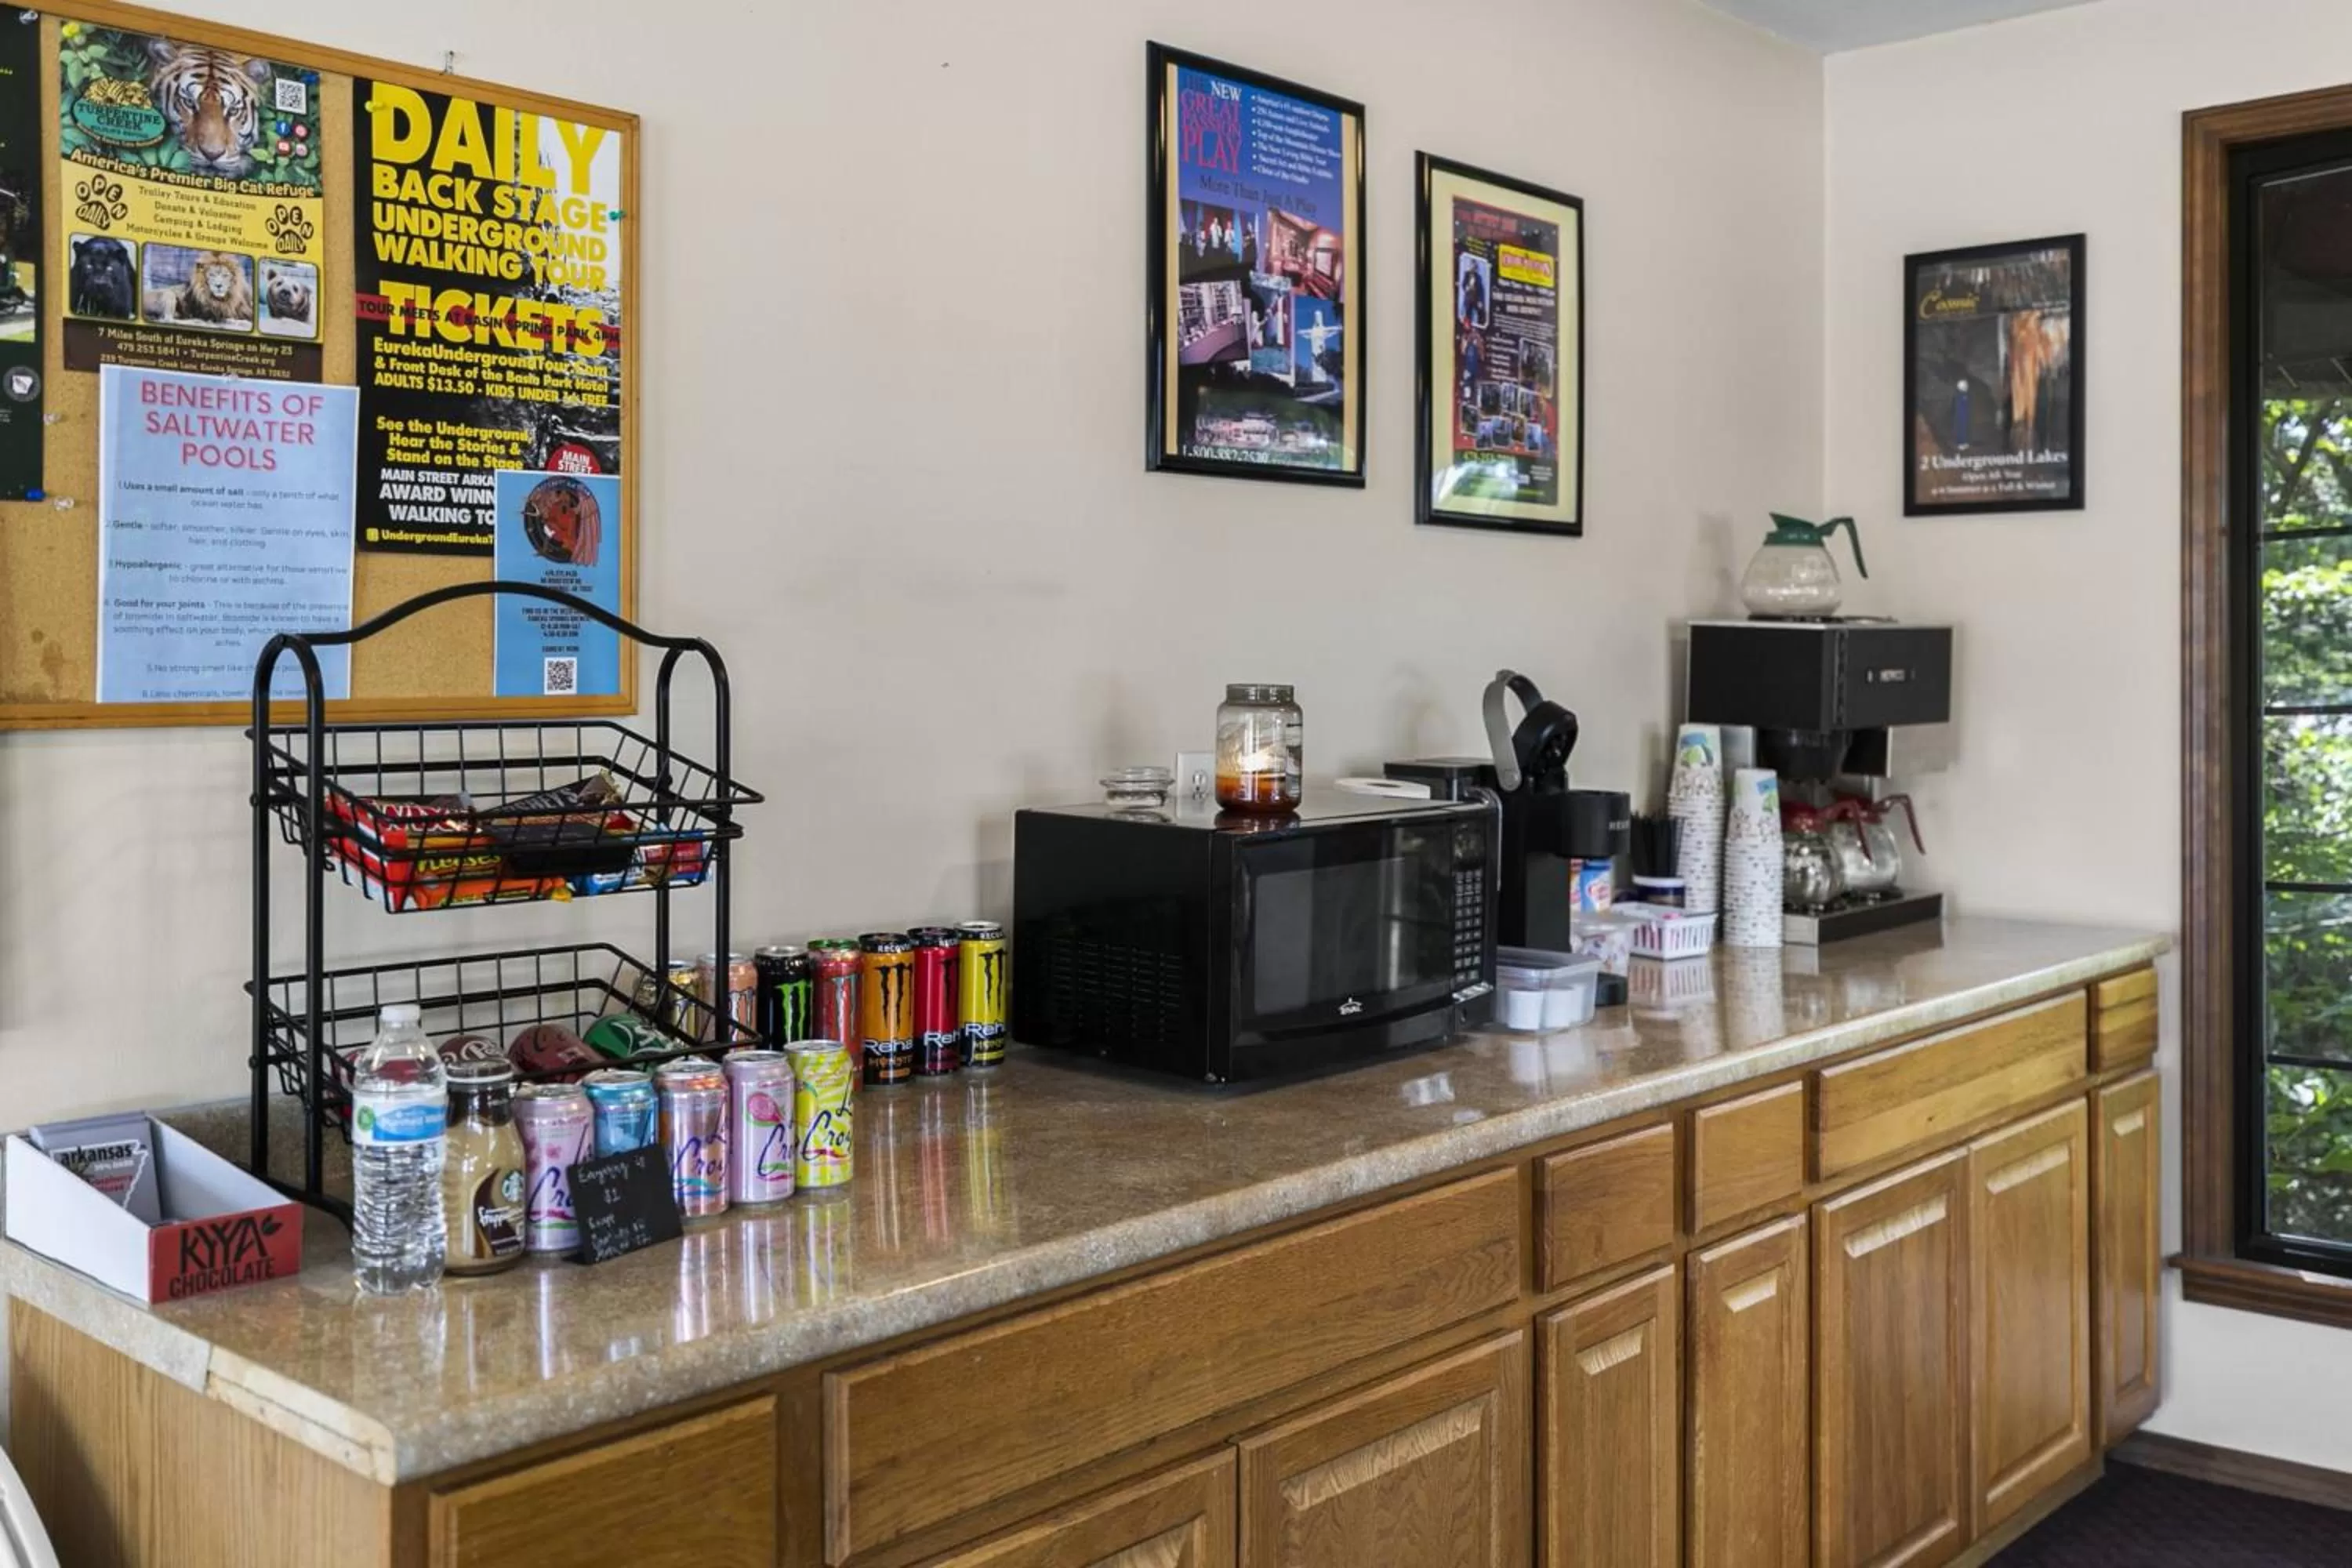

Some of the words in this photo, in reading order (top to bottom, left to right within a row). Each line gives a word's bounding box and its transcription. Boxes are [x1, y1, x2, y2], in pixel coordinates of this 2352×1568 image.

[1210, 80, 1242, 100] NEW
[77, 103, 162, 125] TURPENTINE
[96, 115, 142, 130] CREEK
[372, 81, 607, 196] DAILY
[71, 148, 149, 178] America's
[151, 169, 210, 189] Premier
[214, 176, 236, 194] Big
[239, 180, 266, 194] Cat
[267, 183, 314, 198] Refuge
[138, 185, 171, 200] Trolley
[204, 194, 210, 203] &
[212, 195, 256, 210] Education
[372, 162, 483, 214] BACK
[493, 183, 608, 234] STAGE
[78, 204, 109, 228] DAILY
[154, 201, 185, 214] Donate
[199, 207, 242, 220] Volunteer
[154, 214, 194, 230] Camping
[206, 221, 242, 235] Lodging
[372, 201, 608, 263] UNDERGROUND
[126, 223, 183, 239] Motorcycles
[196, 233, 227, 246] Groups
[230, 236, 269, 250] Welcome
[277, 234, 306, 252] DAILY
[372, 231, 521, 280] WALKING
[528, 256, 606, 292] TOUR
[360, 300, 394, 316] TOUR
[398, 306, 440, 321] MEETS
[557, 325, 588, 339] PARK
[379, 280, 606, 358] TICKETS
[98, 328, 104, 336] 7
[107, 329, 132, 340] Miles
[136, 332, 162, 343] South
[165, 335, 173, 343] of
[176, 335, 207, 347] Eureka
[210, 339, 244, 352] Springs
[260, 343, 278, 355] Hwy
[375, 357, 386, 369] &
[390, 358, 425, 373] Front
[429, 361, 461, 377] Desk
[464, 366, 479, 379] of
[481, 367, 503, 382] the
[506, 371, 539, 386] Basin
[543, 374, 572, 389] Park
[575, 379, 608, 393] Hotel
[141, 380, 271, 414] BENEFITS
[282, 394, 324, 416] OF
[375, 372, 424, 390] ADULTS
[427, 376, 474, 395] $13.50
[485, 383, 515, 399] KIDS
[518, 387, 559, 404] UNDER
[582, 394, 608, 408] FREE
[145, 411, 314, 445] SALTWATER
[376, 416, 405, 431] See
[407, 419, 433, 434] the
[389, 433, 425, 448] Hear
[430, 436, 454, 451] the
[457, 439, 506, 455] Stories
[510, 443, 521, 456] &
[181, 442, 276, 470] POOLS
[387, 448, 430, 464] Stand
[434, 453, 452, 465] on
[456, 452, 479, 467] the
[483, 455, 524, 471] Stage
[557, 460, 593, 474] STREET
[562, 450, 590, 463] MAIN
[1932, 450, 2024, 470] Underground
[2027, 448, 2067, 465] Lakes
[380, 468, 415, 482] MAIN
[418, 470, 459, 485] STREET
[463, 473, 495, 487] ARKA
[124, 482, 145, 491] Uses
[154, 484, 177, 492] small
[180, 486, 213, 495] amount
[216, 486, 226, 495] of
[228, 488, 244, 496] salt
[379, 484, 446, 502] AWARD
[450, 488, 495, 504] WINN
[113, 521, 143, 529] Gentle
[389, 504, 471, 523] WALKING
[475, 510, 495, 525] TO
[381, 529, 493, 546] UndergroundEurekaT
[115, 561, 181, 573] Hypoallergenic
[114, 598, 139, 608] Good
[140, 598, 154, 608] for
[157, 601, 176, 611] your
[178, 599, 205, 611] joints
[924, 1029, 960, 1048] Reh
[965, 1022, 1004, 1040] Reh
[864, 1040, 913, 1057] Reha
[60, 1145, 132, 1165] arkansas
[169, 1258, 276, 1299] CHOCOLATE
